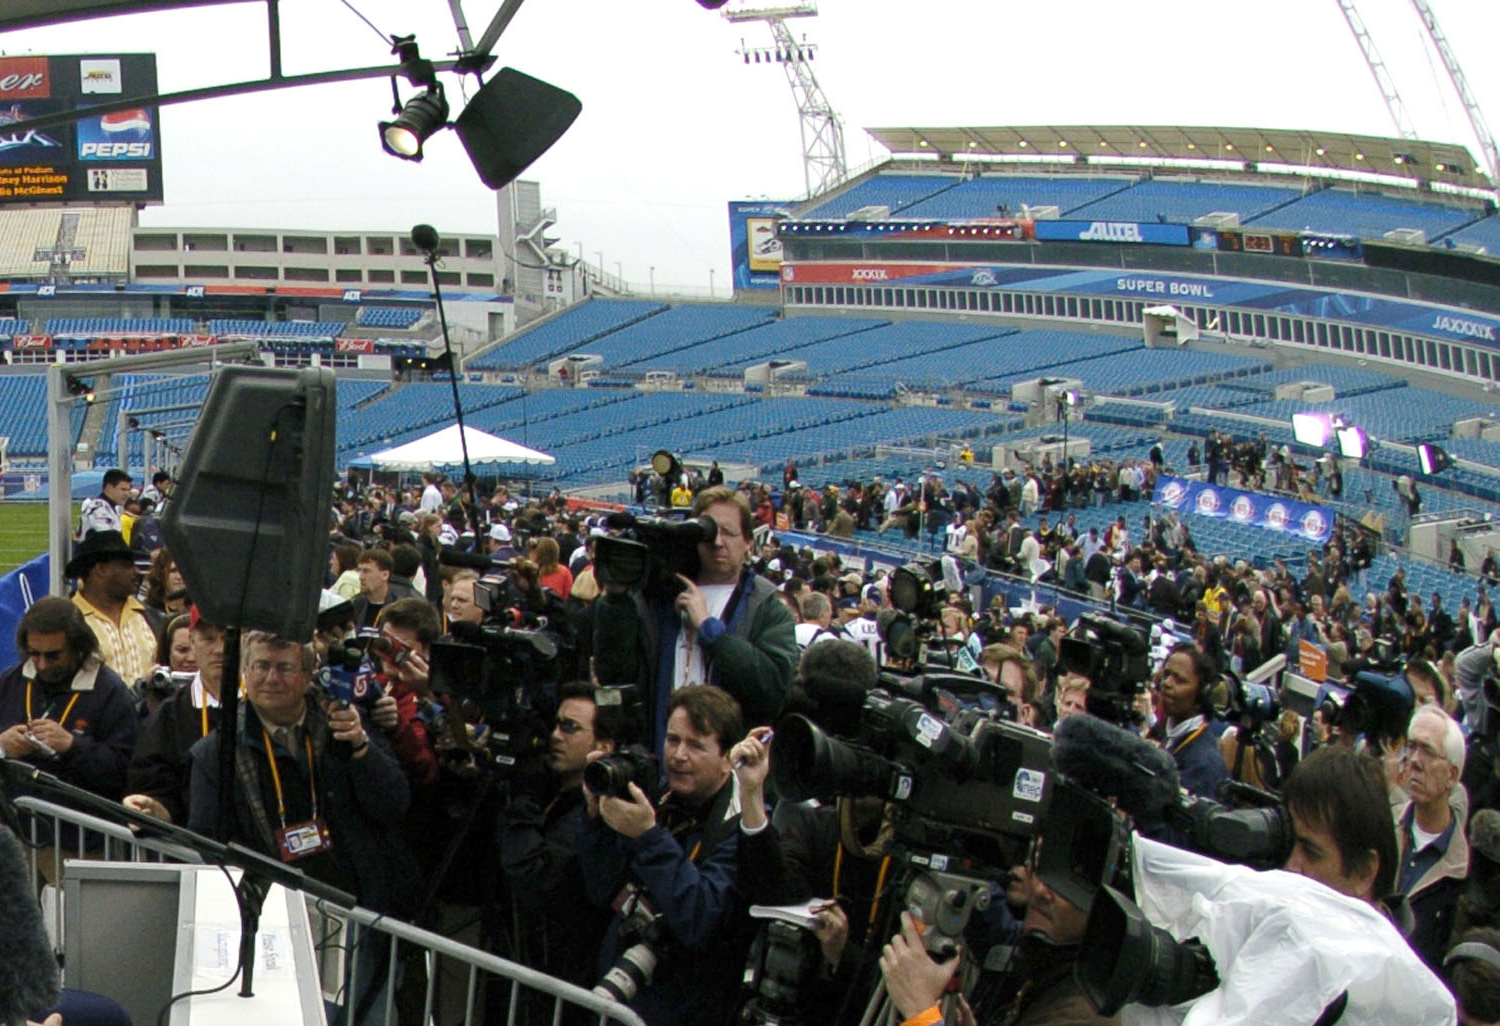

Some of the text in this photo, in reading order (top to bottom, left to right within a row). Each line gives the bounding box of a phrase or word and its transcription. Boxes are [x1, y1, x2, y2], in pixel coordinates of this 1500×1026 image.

[80, 142, 151, 157] PEPSI
[22, 175, 68, 184] Harrison
[1117, 278, 1213, 297] SUPER BOWL
